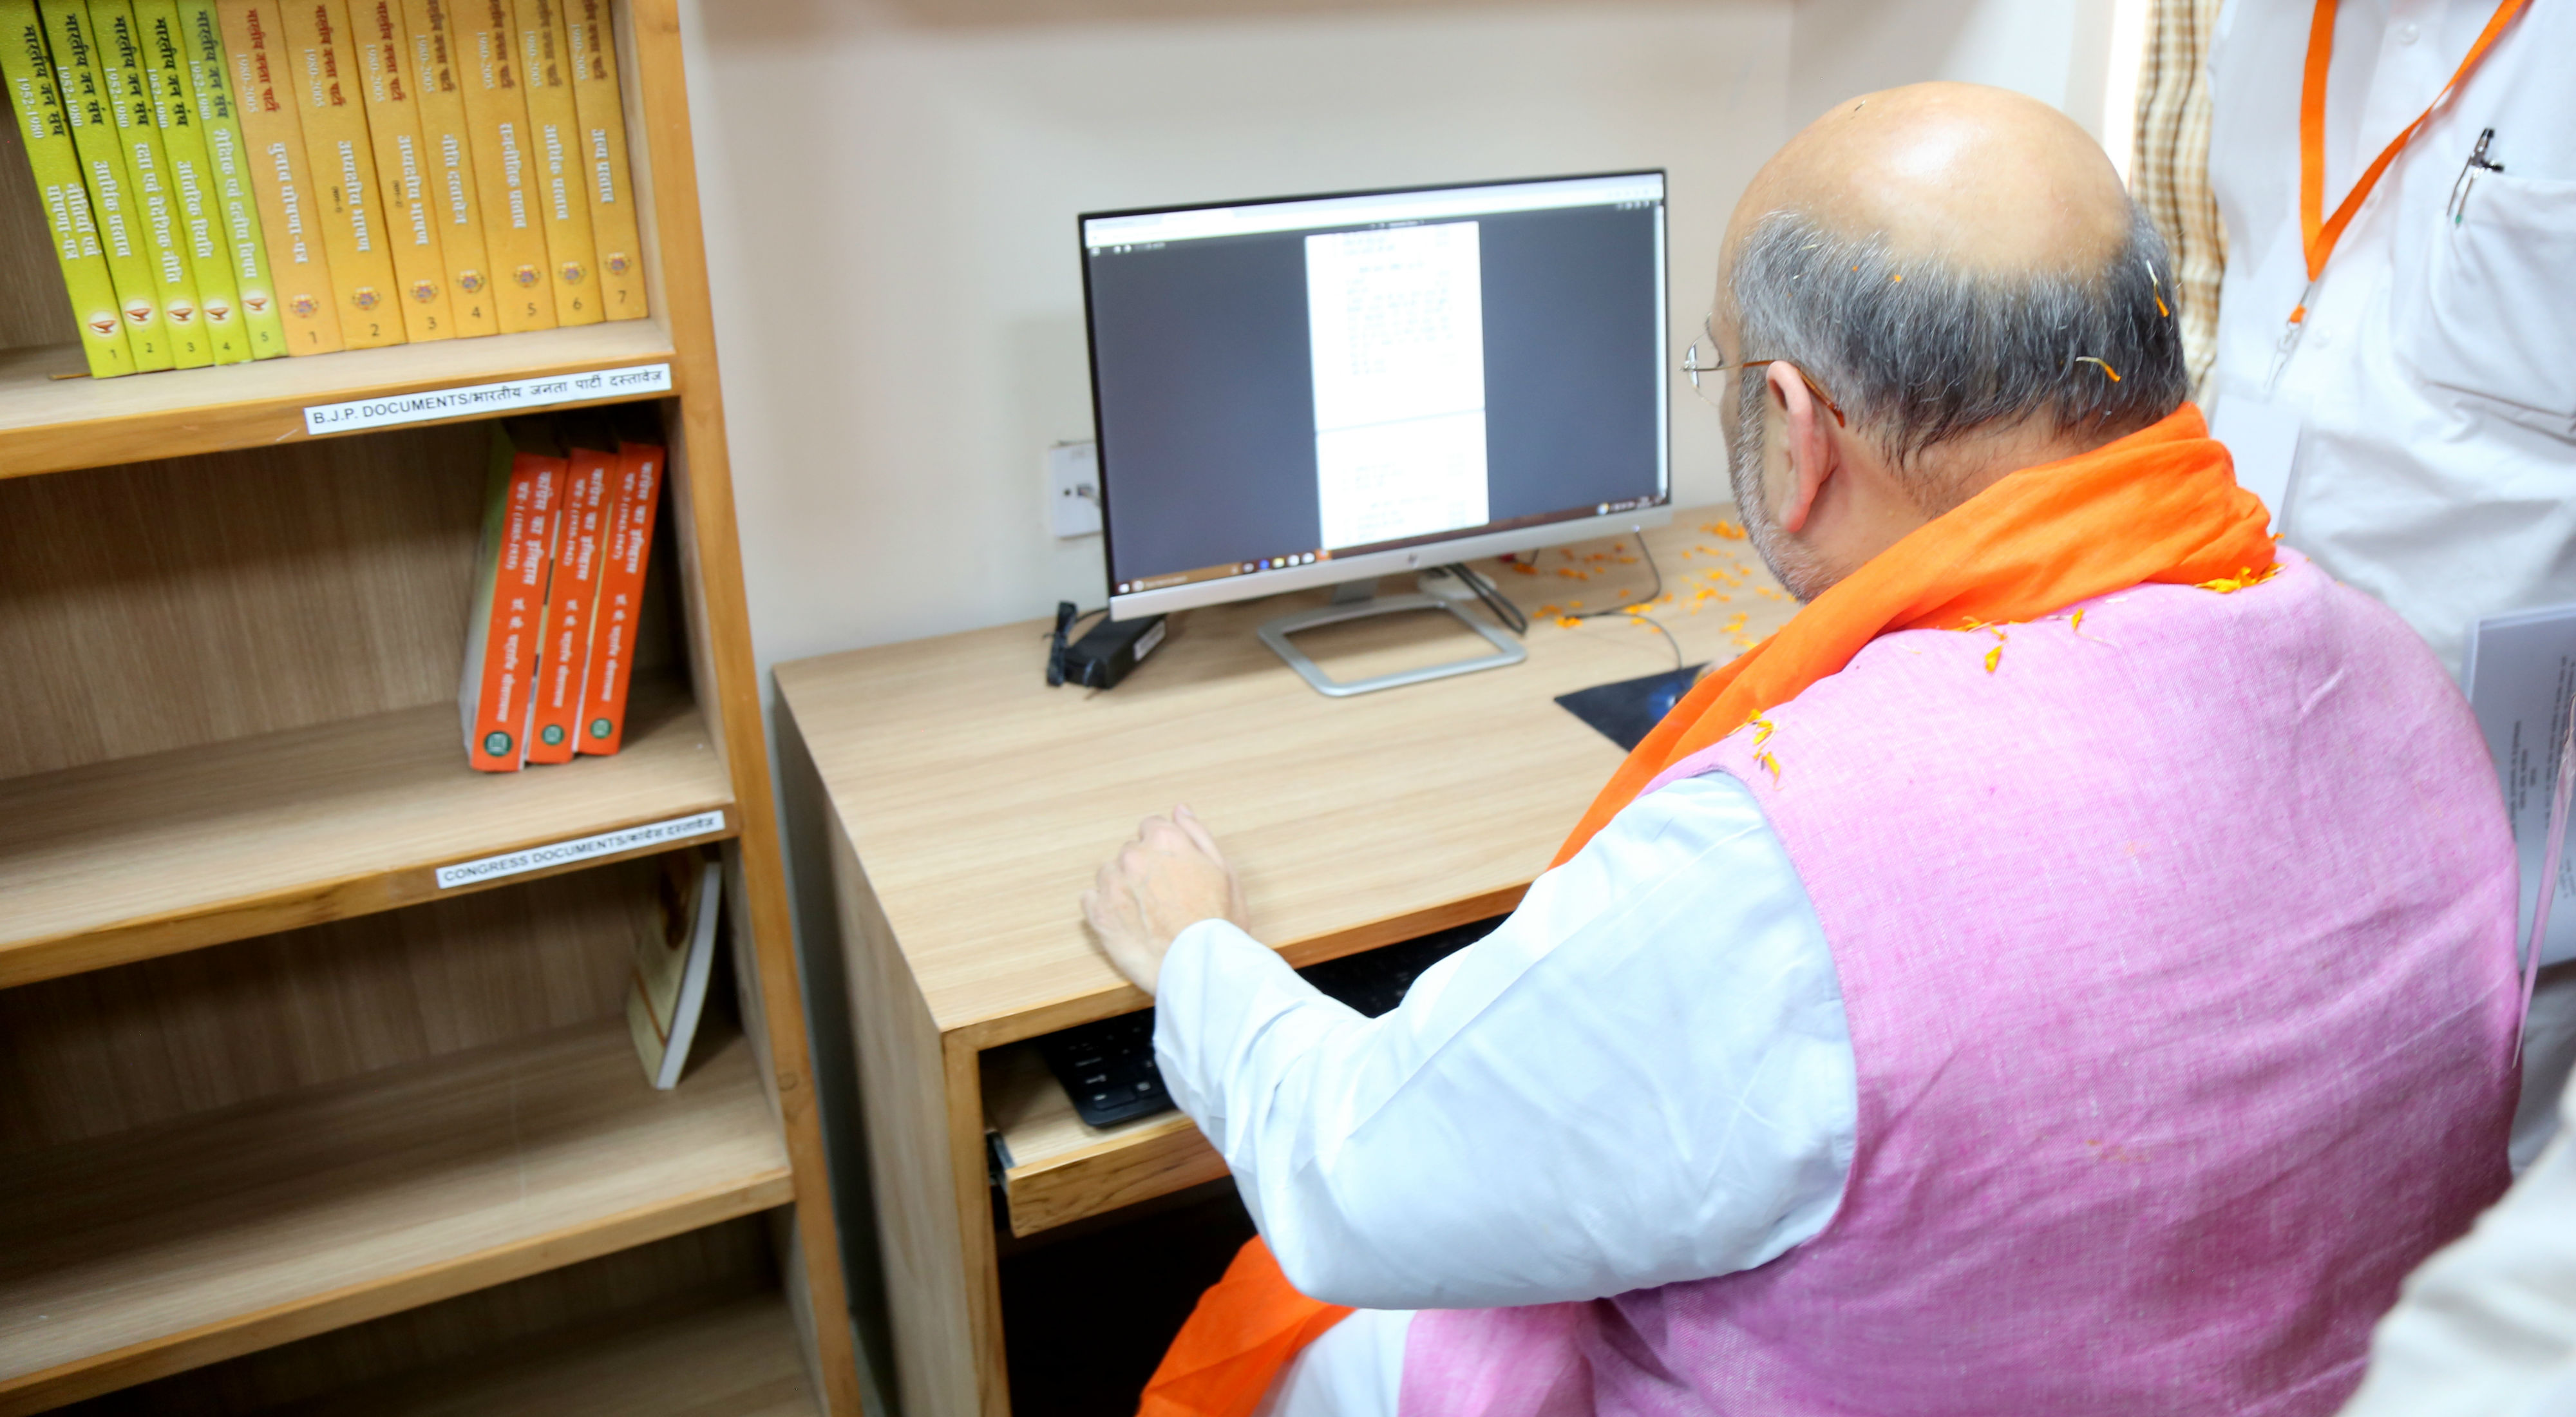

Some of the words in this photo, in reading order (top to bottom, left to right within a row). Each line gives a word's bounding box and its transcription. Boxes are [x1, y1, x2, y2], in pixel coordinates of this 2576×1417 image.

[196, 10, 218, 62] भारतीय
[246, 8, 266, 49] भारतीय
[315, 4, 334, 44] भारतीय
[376, 1, 394, 40] भारतीय
[24, 24, 49, 78] भारतीय
[66, 14, 89, 66] भारतीय
[114, 15, 137, 68] भारतीय
[155, 17, 177, 70] भारतीय
[434, 33, 448, 63] जनता
[256, 52, 270, 82] जनता
[323, 48, 337, 78] जनता
[366, 44, 385, 102] 1980-2005
[384, 43, 397, 73] जनता
[415, 34, 435, 92] 1980-2005
[477, 31, 495, 89] 1980-2005
[41, 83, 57, 106] जन
[80, 71, 95, 95] जन
[128, 73, 142, 96] जन
[168, 75, 182, 97] जन
[189, 61, 211, 119] 1952-1980
[209, 67, 222, 89] जन
[236, 54, 258, 113] 1980-2005
[304, 49, 325, 107] 1980-2005
[329, 81, 346, 106] पार्टी
[390, 77, 406, 101] पार्टी
[439, 66, 456, 91] पार्टी
[16, 78, 44, 138] 1952-1980
[57, 66, 83, 126] 1952-1980
[86, 100, 106, 124] संघ
[104, 68, 129, 128] 1952-1980
[133, 101, 152, 125] संघ
[147, 68, 169, 128] 1952-1980
[213, 94, 232, 118] संघ
[262, 86, 281, 111] पार्टी
[48, 111, 66, 136] संघ
[173, 102, 191, 126] संघ
[134, 142, 154, 169] रक्षा
[213, 128, 235, 175] शैक्षिक
[442, 134, 460, 167] नीति
[498, 122, 522, 187] राजनीतिक
[544, 124, 564, 175] आर्थिक
[591, 128, 607, 158] अन्य
[142, 173, 163, 193] एवं
[225, 178, 244, 198] एवं
[337, 140, 363, 205] अध्यक्षीय
[352, 209, 371, 251] भाषण
[397, 135, 421, 198] अध्यक्षीय
[410, 203, 430, 244] भाषण
[552, 177, 569, 220] प्रस्ताव
[596, 161, 614, 204] प्रस्ताव
[93, 160, 120, 211] आर्थिक
[108, 214, 131, 256] प्रस्ताव
[176, 161, 203, 216] आंतरिक
[191, 218, 213, 258] स्थिति
[267, 142, 292, 182] चुनाव
[281, 185, 308, 263] घोषणा-पत्र
[509, 189, 527, 228] प्रस्ताव
[47, 184, 80, 260] घोषणा-पत्र
[148, 195, 172, 248] वैदेशिक
[229, 202, 250, 240] दलीय
[162, 251, 182, 283] नीति
[238, 242, 256, 278] विषय
[471, 306, 481, 318] 4
[526, 302, 537, 316] 5
[573, 297, 582, 310] 6
[618, 290, 627, 303] 7
[261, 332, 269, 342] 5
[310, 332, 317, 343] 1
[370, 324, 380, 336] 2
[427, 317, 437, 329] 3
[110, 349, 117, 359] 1
[146, 343, 153, 352] 2
[187, 343, 194, 352] 3
[223, 342, 231, 350] 4
[314, 407, 358, 424] B.J.P.
[363, 385, 522, 417] DOCUMENTS/भारतीय
[530, 381, 567, 396] जनता
[576, 373, 602, 390] पार्टी
[534, 471, 553, 511] कांग्रेस
[588, 468, 604, 507] कांग्रेस
[637, 461, 654, 500] कांग्रेस
[530, 515, 545, 535] का
[584, 511, 597, 531] का
[634, 504, 646, 524] का
[523, 539, 545, 586] इतिहास
[576, 535, 596, 580] इतिहास
[625, 528, 645, 575] इतिहास
[444, 855, 528, 882] CONGRESS
